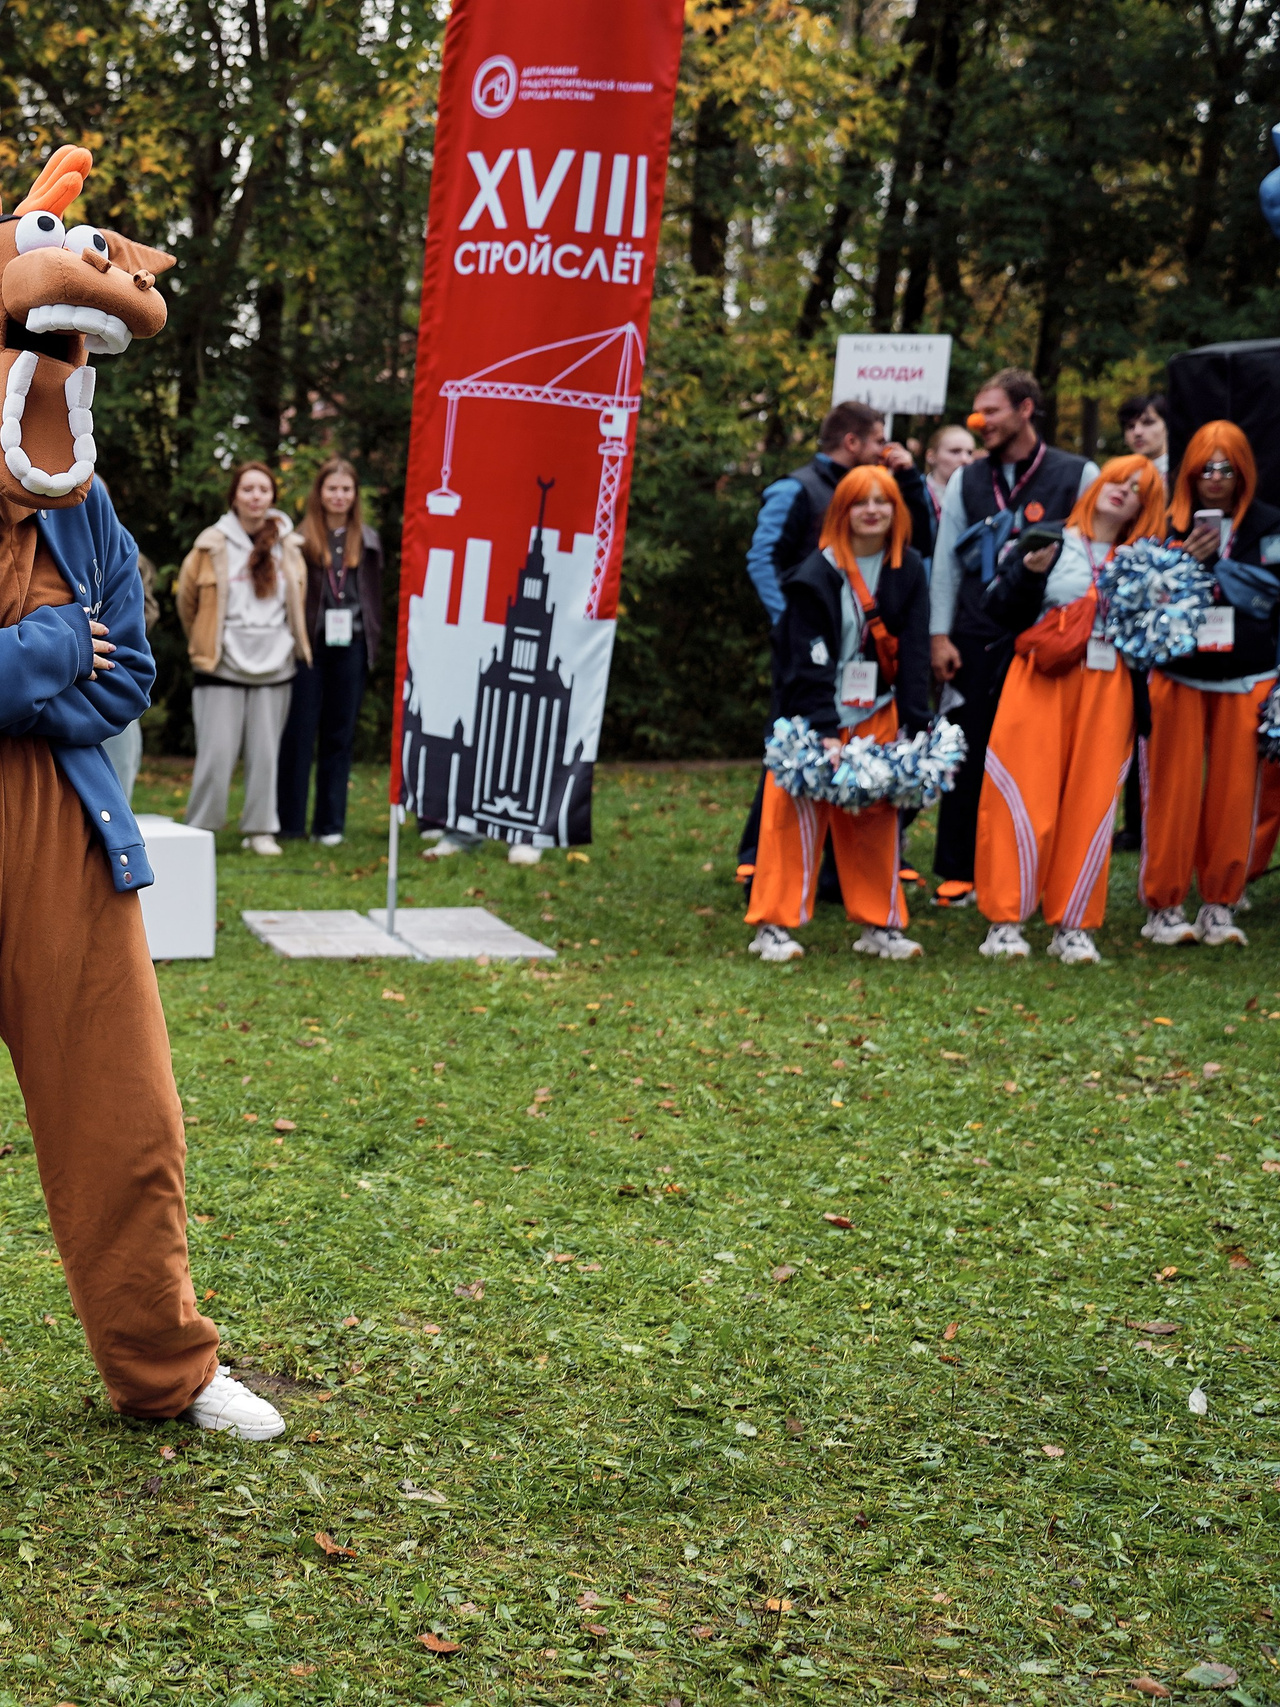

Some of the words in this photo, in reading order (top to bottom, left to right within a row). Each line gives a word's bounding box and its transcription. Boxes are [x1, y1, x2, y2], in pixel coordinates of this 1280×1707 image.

[459, 148, 648, 238] XVIII
[454, 234, 644, 285] СТРОЙСЛЁТ
[857, 366, 925, 382] КОЛДИ
